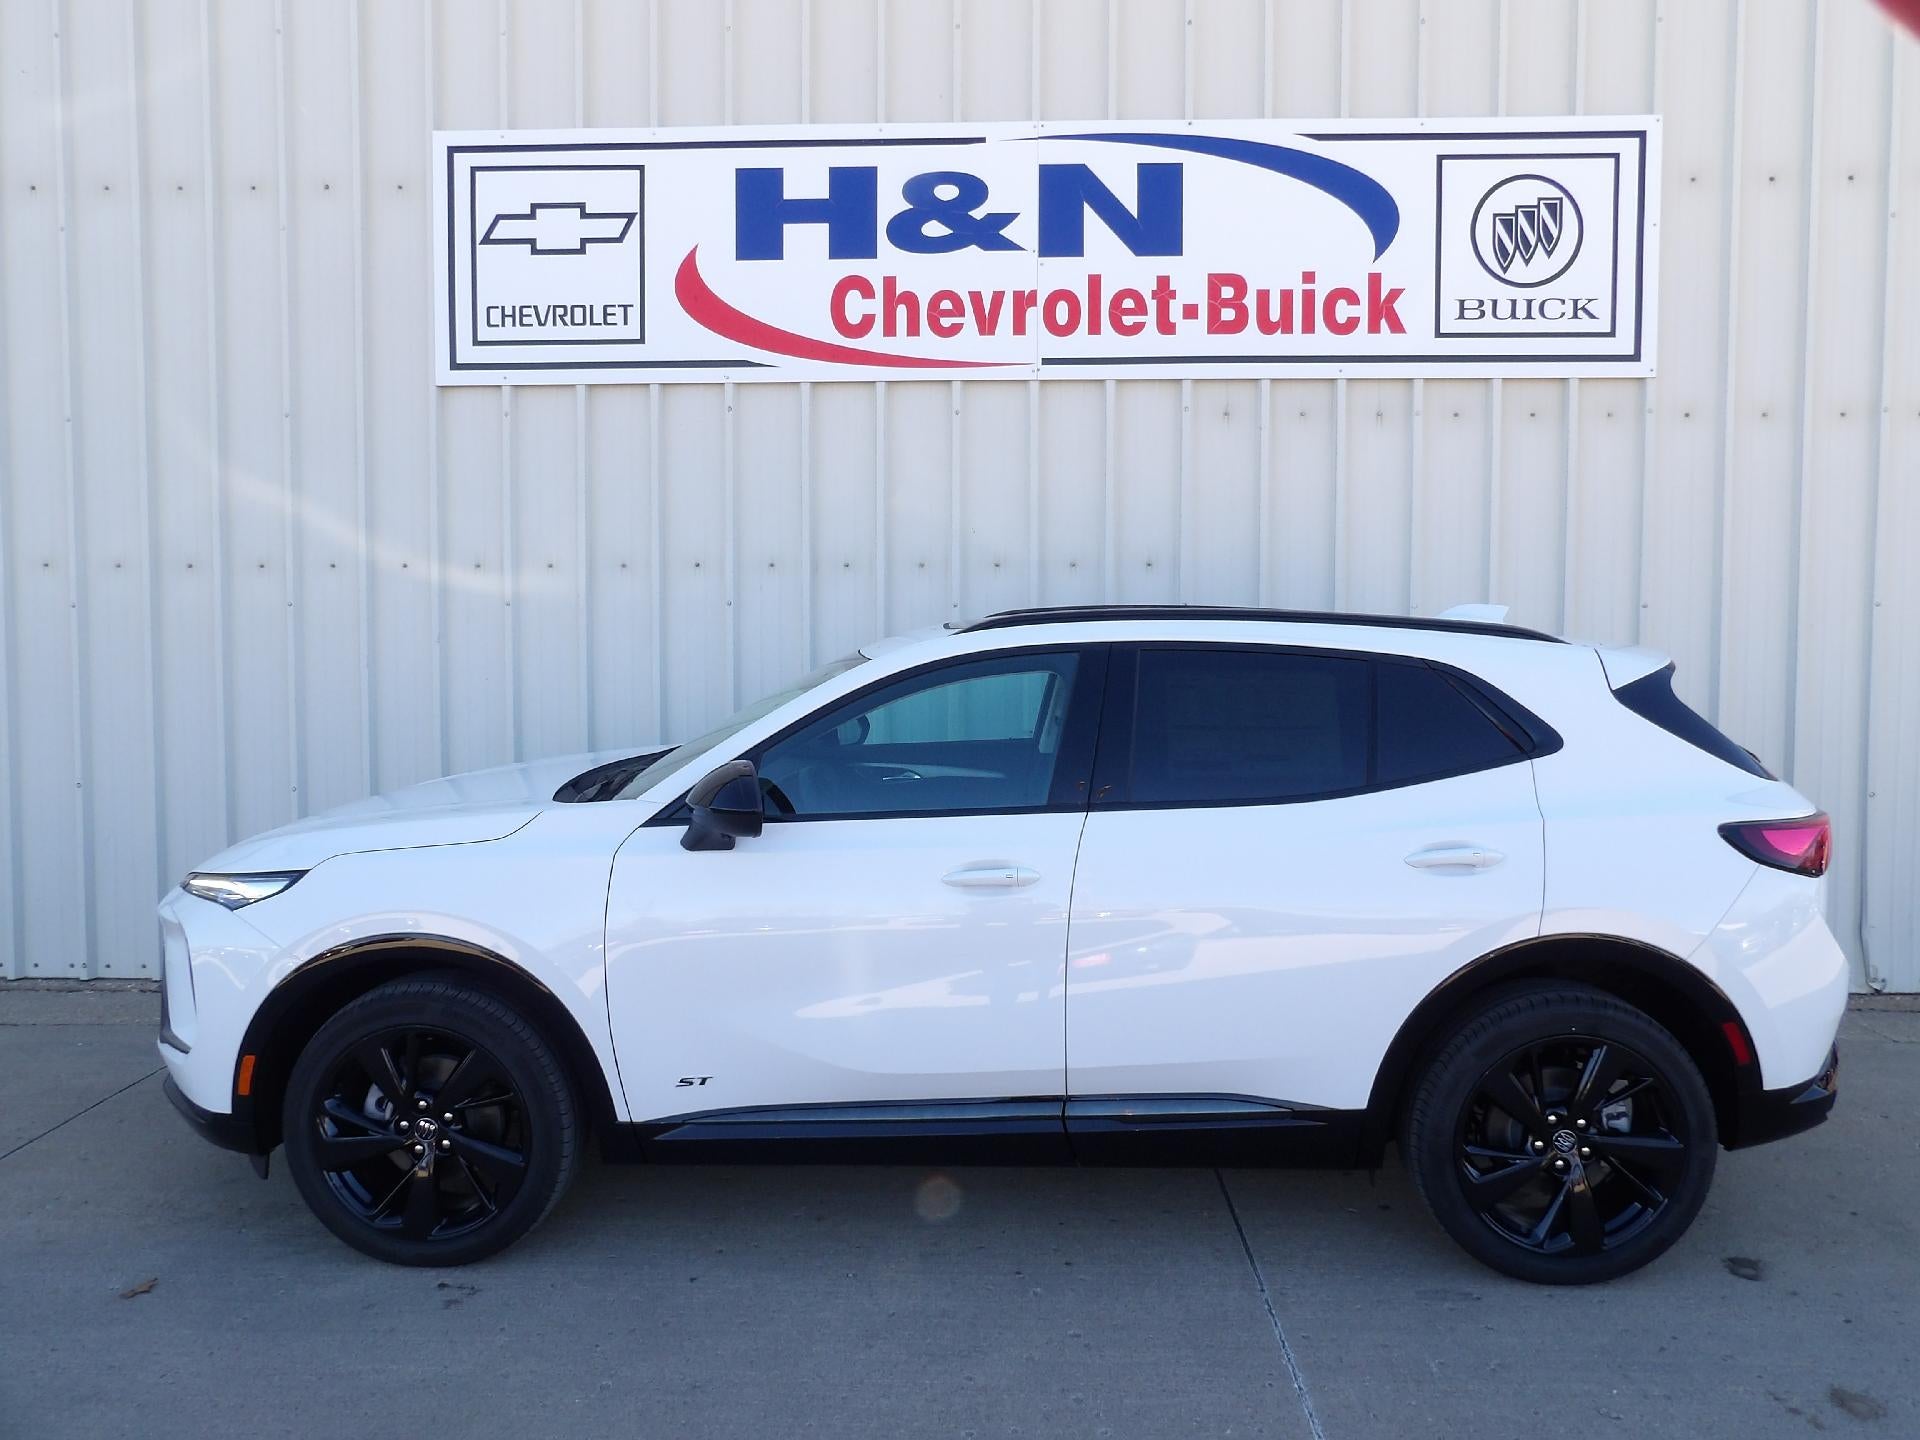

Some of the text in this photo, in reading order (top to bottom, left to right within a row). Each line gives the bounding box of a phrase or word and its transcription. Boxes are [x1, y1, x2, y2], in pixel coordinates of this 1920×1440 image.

[735, 162, 1183, 260] H&N
[486, 304, 634, 328] CHEVROLET
[830, 271, 1407, 339] Chevrolet-Buick
[1454, 297, 1600, 320] BUICK
[675, 1076, 713, 1087] ST
